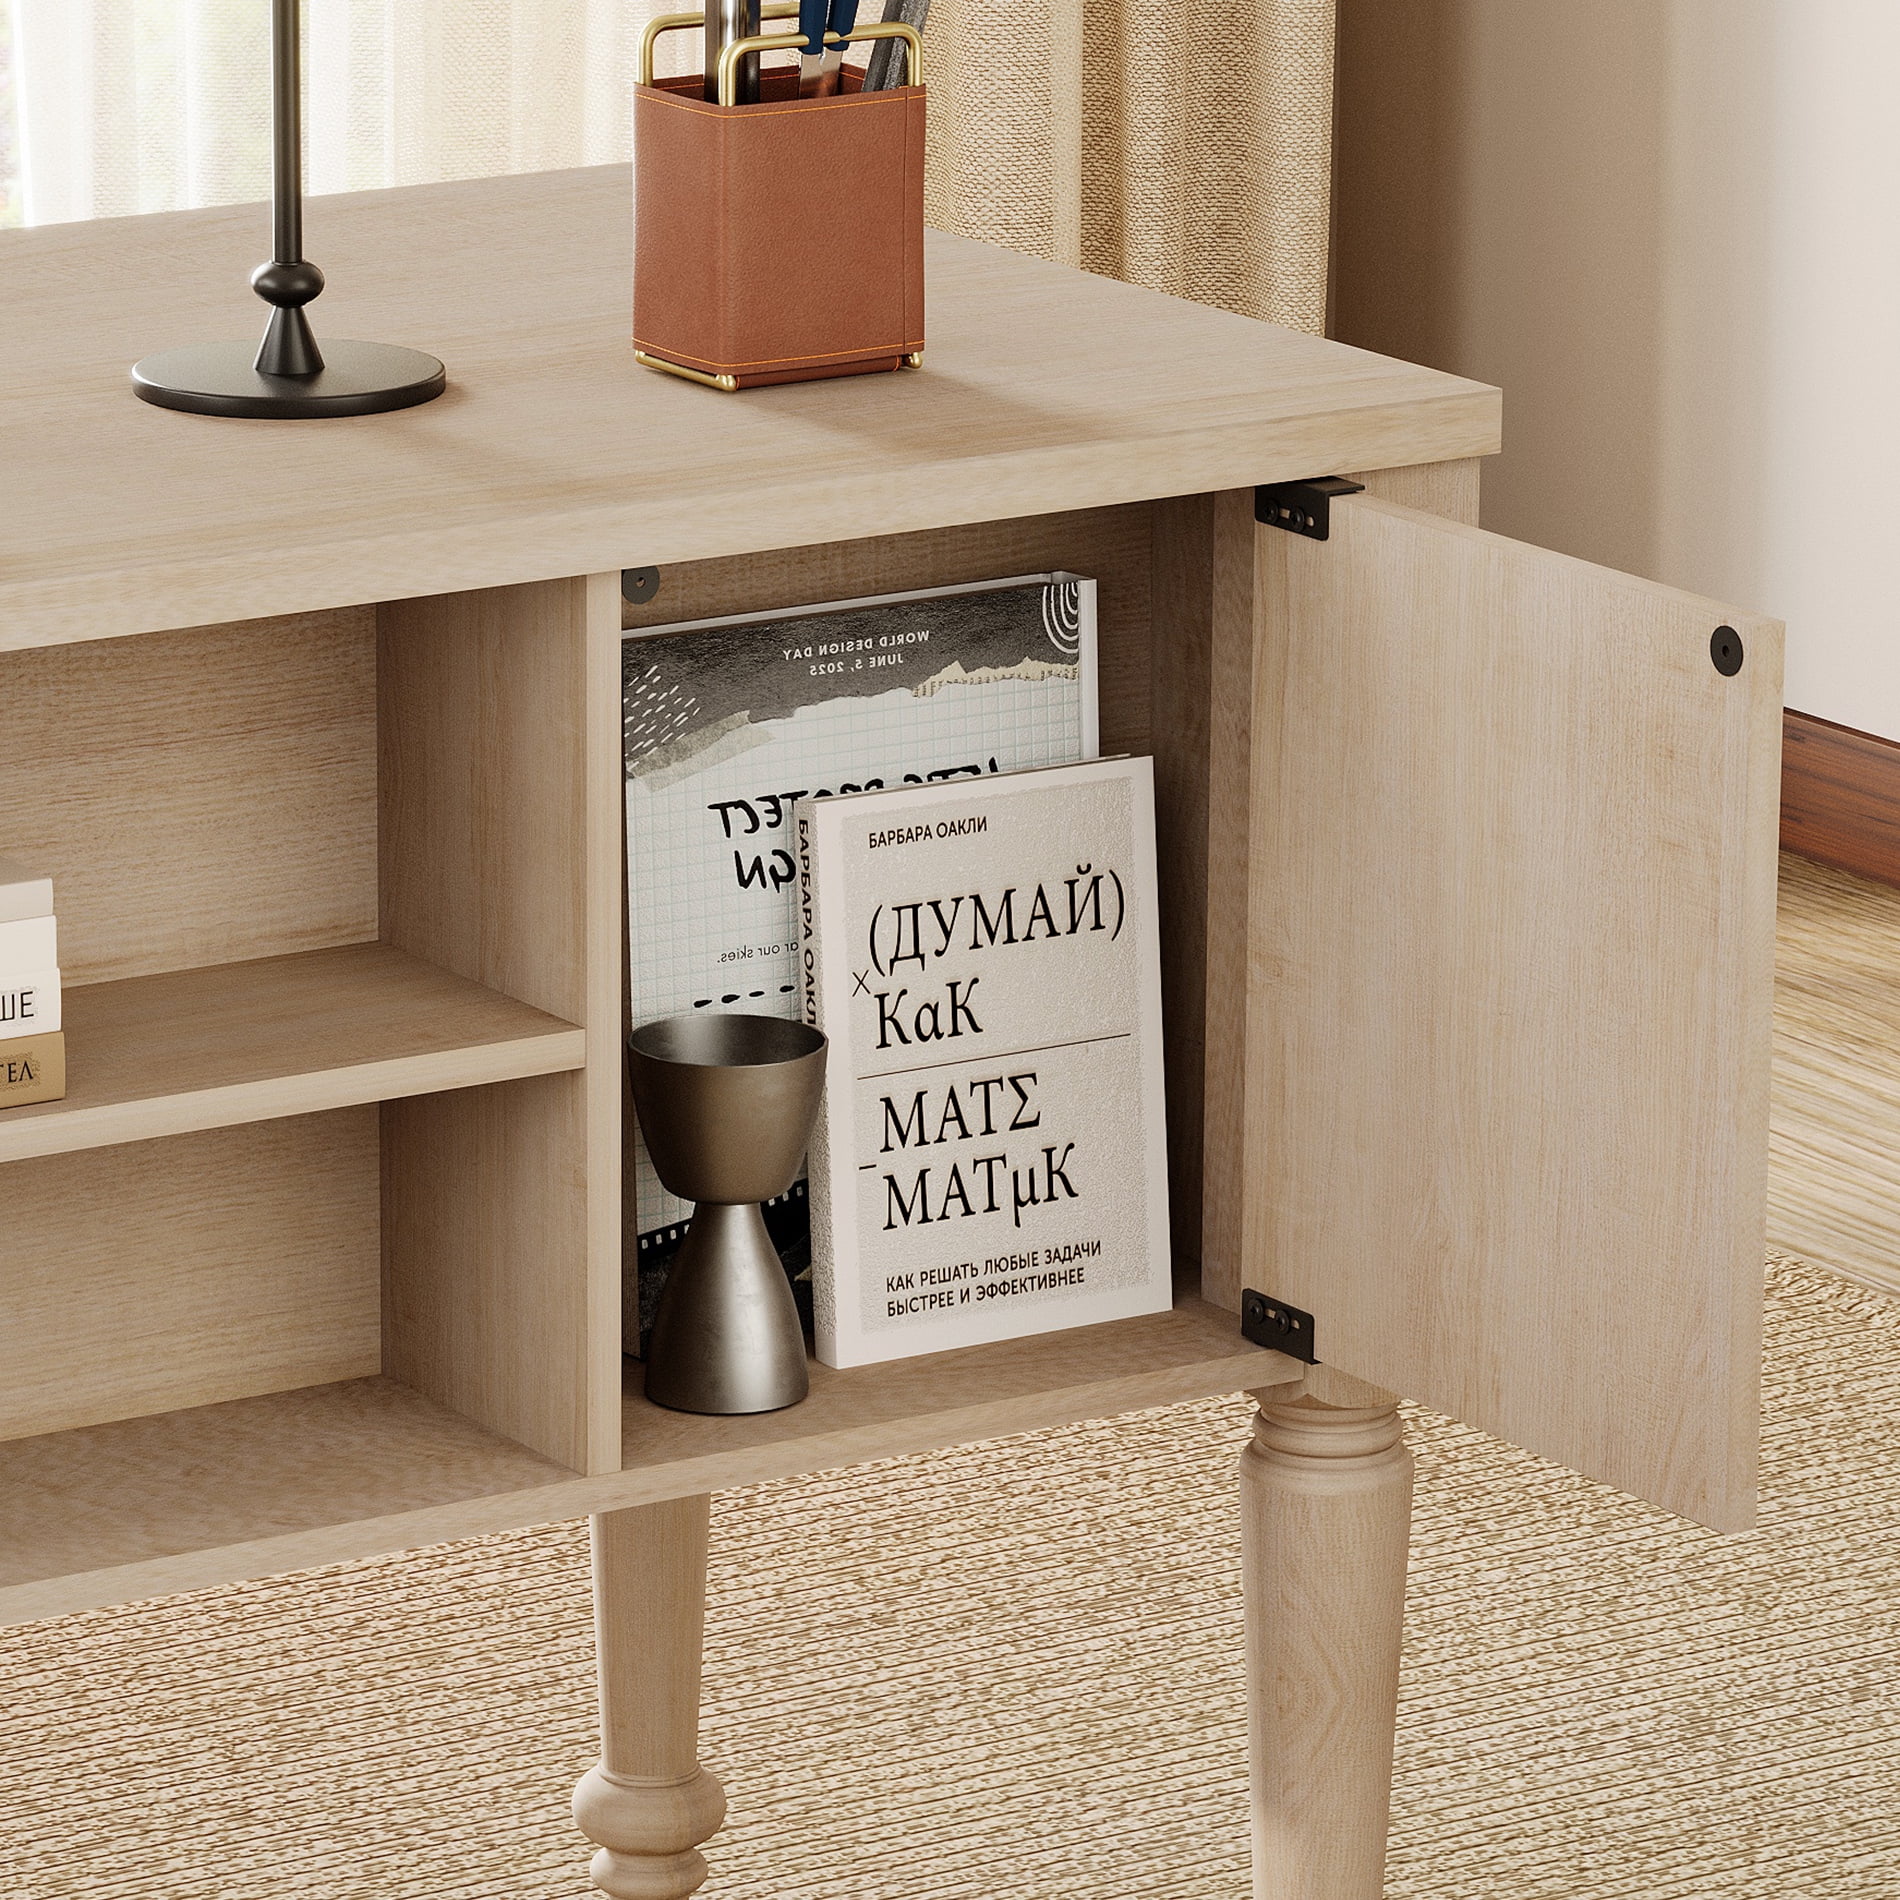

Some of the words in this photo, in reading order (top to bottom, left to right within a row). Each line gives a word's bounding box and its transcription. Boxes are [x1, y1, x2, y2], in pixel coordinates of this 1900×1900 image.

[868, 827, 933, 849] БАРБАРА
[936, 816, 988, 838] ОАКЛИ
[798, 819, 813, 941] БАРБАРА
[869, 863, 1125, 977] (ДУМАЙ)
[886, 1272, 914, 1293] КАК
[920, 1263, 979, 1287] РЕШАТЬ
[984, 1251, 1040, 1276] ЛЮБЫЕ
[1044, 1240, 1102, 1265] ЗАДАЧИ
[887, 1290, 955, 1317] БЫСТРЕЕ
[960, 1287, 971, 1304] И
[976, 1267, 1085, 1301] ЭФФЕКТИВНЕЕ
